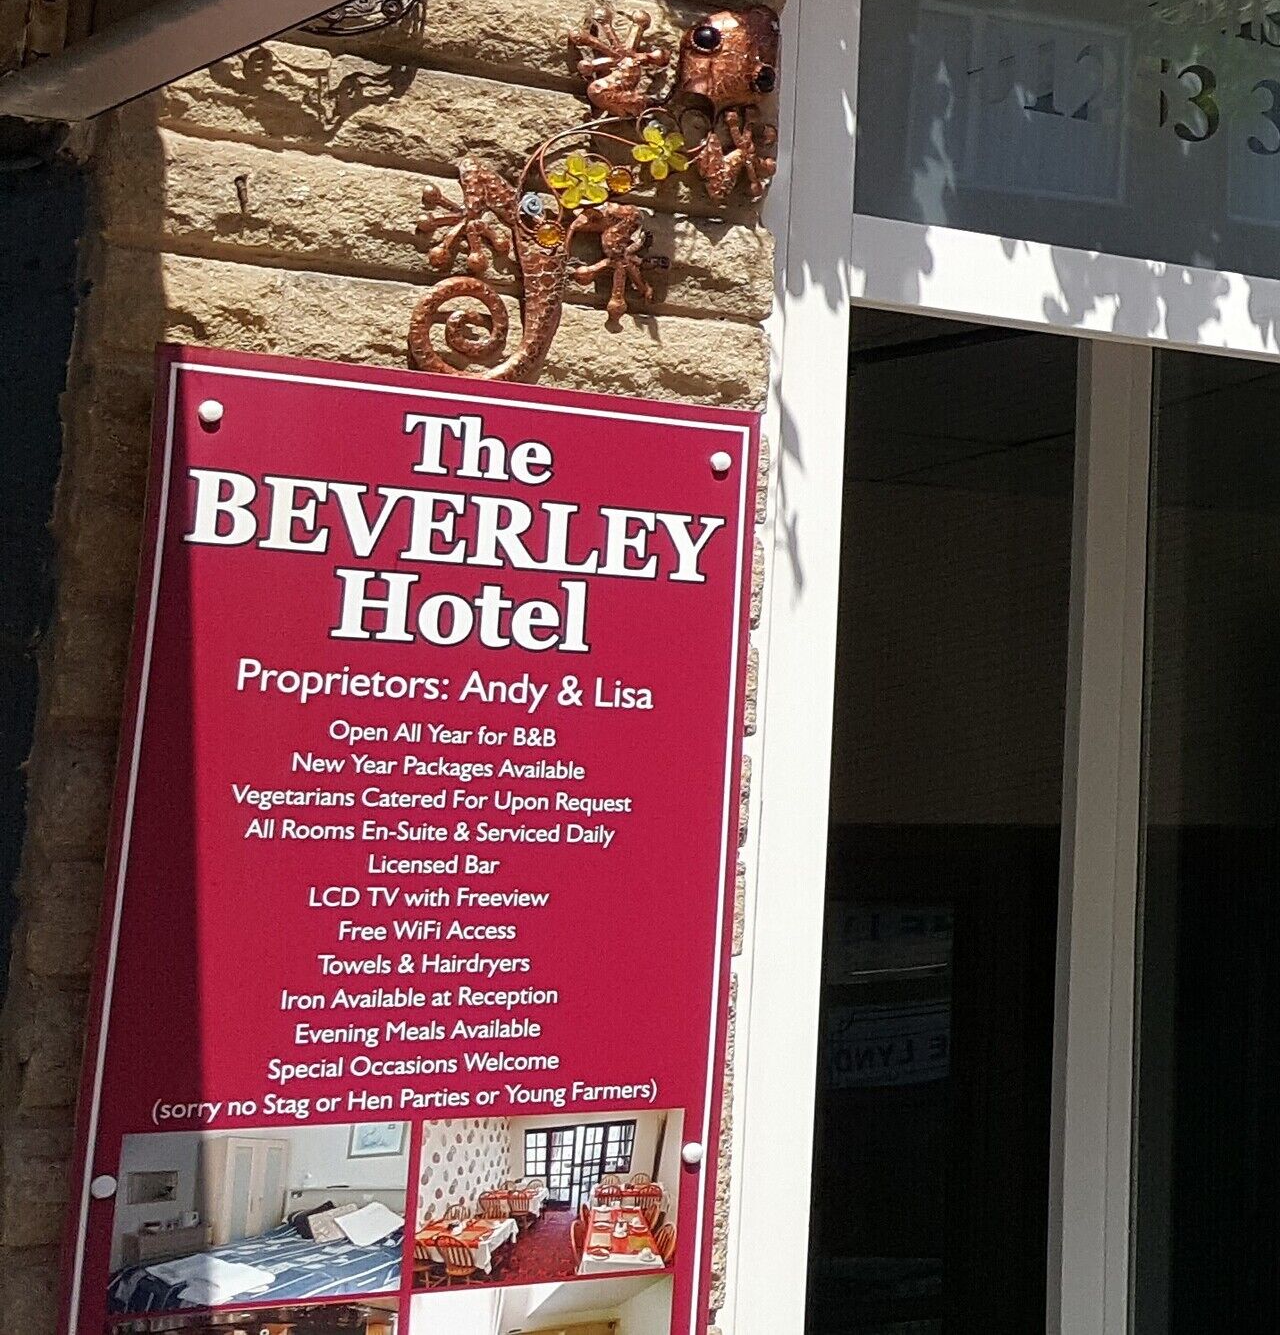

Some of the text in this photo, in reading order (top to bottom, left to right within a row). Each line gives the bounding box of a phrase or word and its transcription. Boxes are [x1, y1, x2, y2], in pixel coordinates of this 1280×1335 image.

[404, 413, 552, 485] The
[183, 463, 725, 583] BEVERLEY
[330, 568, 589, 652] Hotel
[236, 657, 654, 714] Proprietors: Andy & Lisa
[328, 719, 557, 748] Open All Year for B&B
[291, 751, 586, 783] New Year Packages Available
[231, 783, 633, 817] Vegetarians Catered For Upon Request
[244, 818, 616, 849] All Rooms En-Suite & Serviced Daily
[367, 853, 501, 875] Licensed Bar
[308, 886, 550, 908] LCD TV with Freeview
[338, 919, 517, 941] Free WiFi Access
[317, 952, 531, 979] Towels & Hairdryers
[280, 985, 559, 1011] Iron Available at Reception
[294, 1017, 542, 1048] Evening Meals Available
[267, 1051, 560, 1086] Special Occasions Welcome
[151, 1078, 658, 1126] (sorry no Stag or Hen Parties or Young Farmers)
